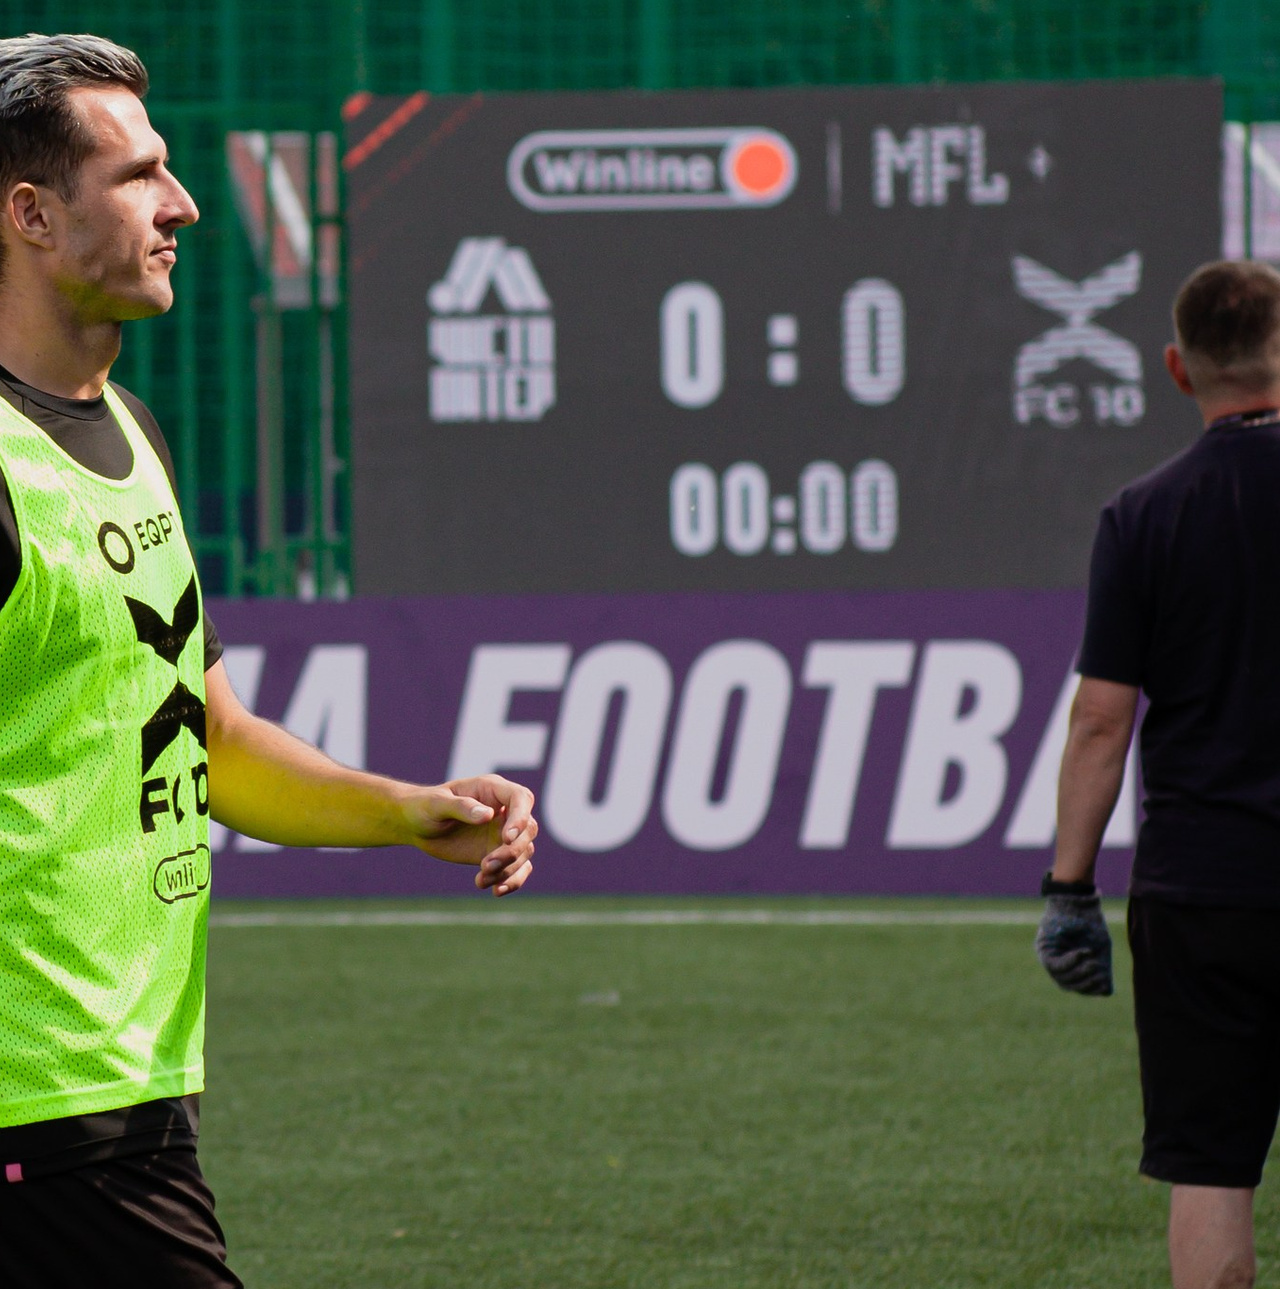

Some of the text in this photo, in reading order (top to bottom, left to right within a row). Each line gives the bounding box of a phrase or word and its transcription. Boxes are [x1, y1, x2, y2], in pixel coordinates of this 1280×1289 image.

[531, 148, 716, 193] Winline
[873, 125, 1010, 207] MFL
[661, 282, 724, 408] 0
[842, 278, 905, 406] 0
[1014, 383, 1145, 427] FC 10
[669, 460, 899, 557] 00:00
